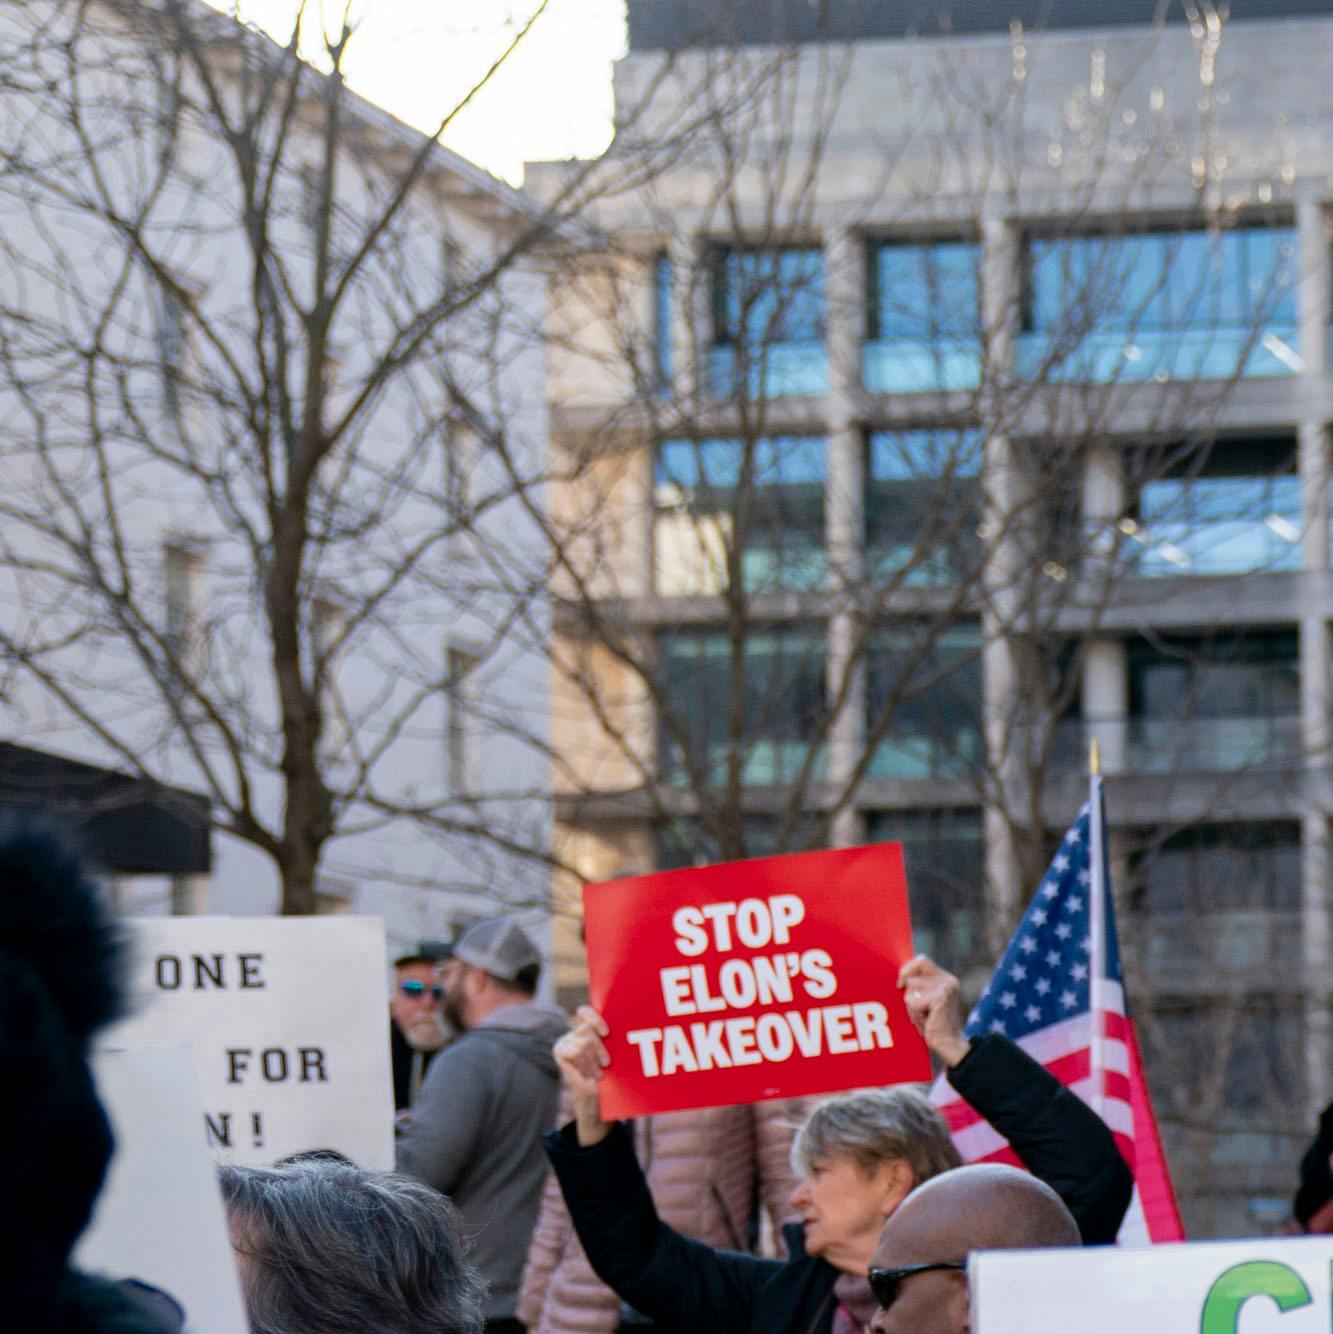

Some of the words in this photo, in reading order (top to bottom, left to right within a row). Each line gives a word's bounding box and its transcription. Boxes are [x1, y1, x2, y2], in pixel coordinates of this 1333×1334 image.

[672, 893, 806, 957] STOP
[155, 952, 265, 990] ONE
[659, 948, 838, 1017] ELON’S
[227, 1047, 328, 1084] FOR
[626, 1001, 894, 1078] TAKEOVER
